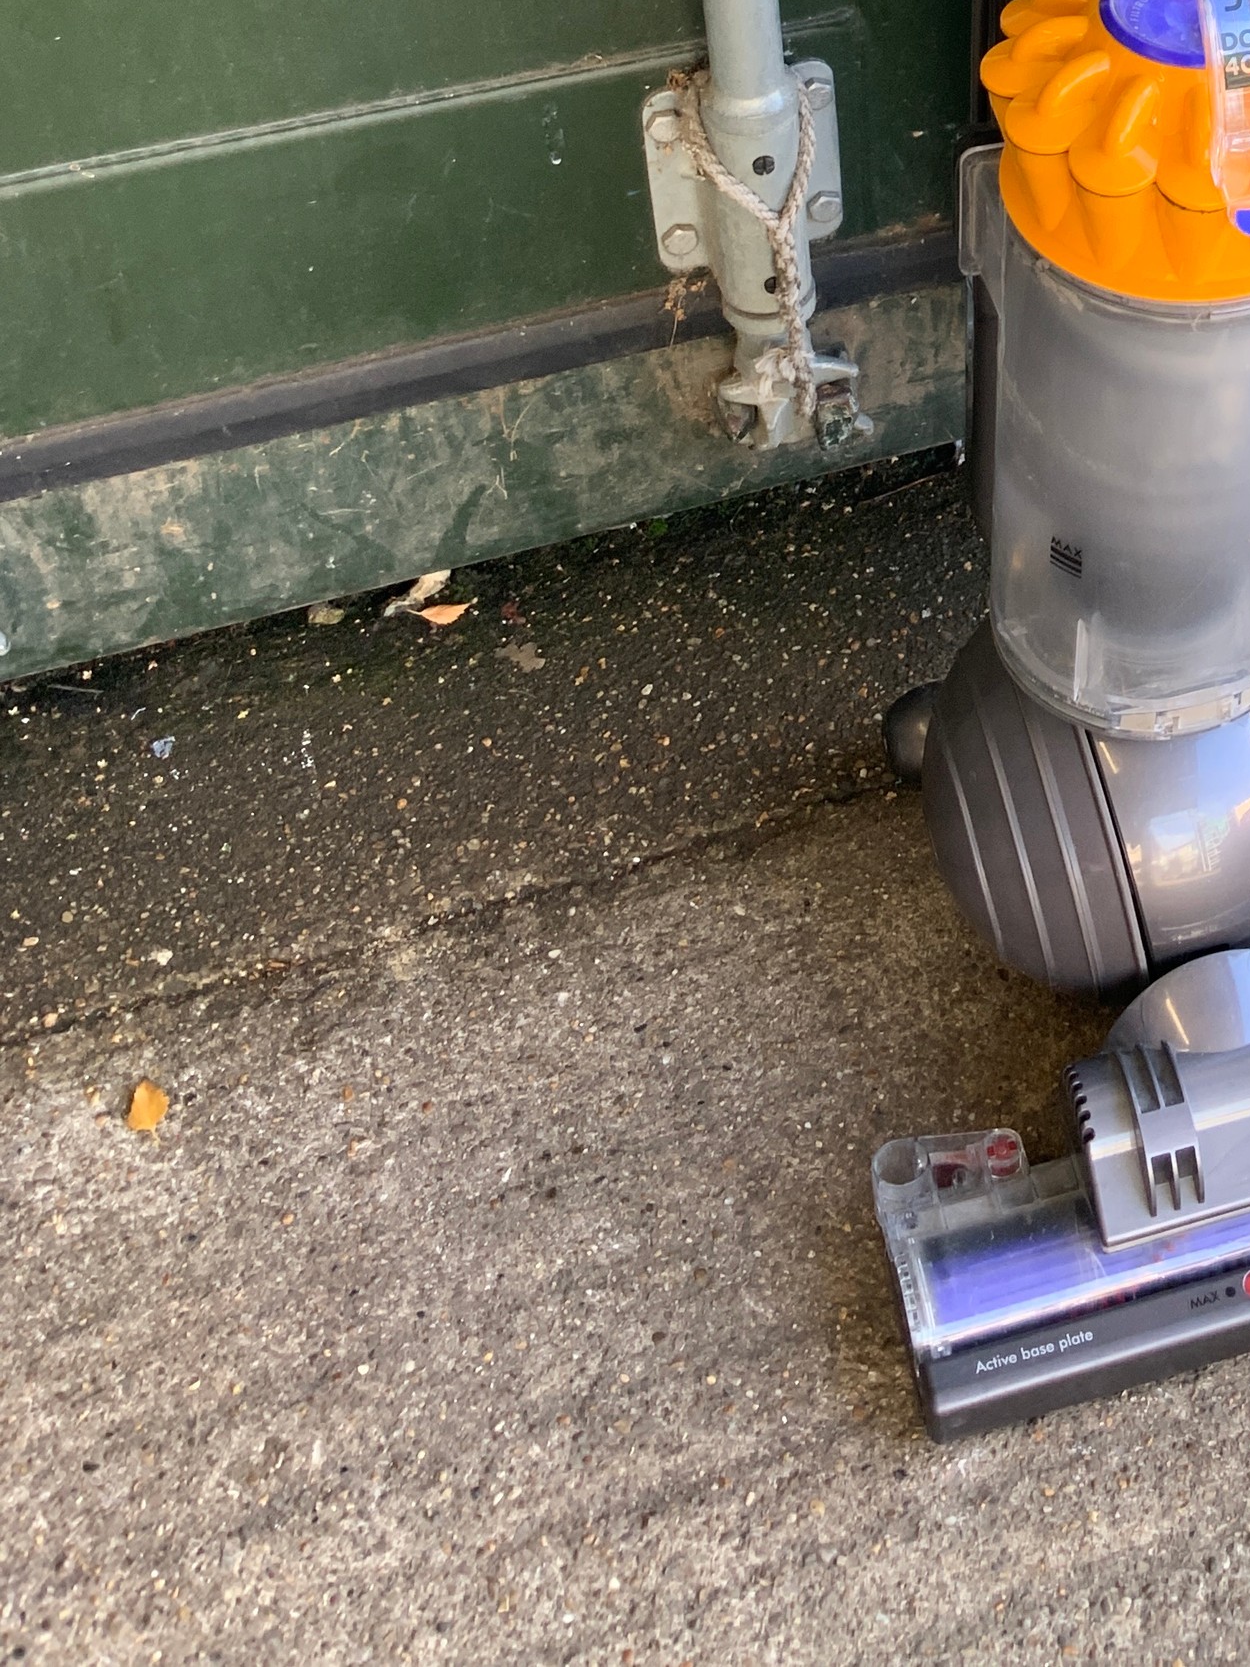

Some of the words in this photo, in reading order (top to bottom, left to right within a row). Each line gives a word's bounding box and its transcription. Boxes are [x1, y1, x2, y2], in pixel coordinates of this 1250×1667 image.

[1051, 536, 1082, 559] MAX
[1190, 1290, 1220, 1310] MAX
[976, 1354, 1018, 1374] Active
[1020, 1343, 1055, 1360] base
[1058, 1331, 1094, 1352] plate
